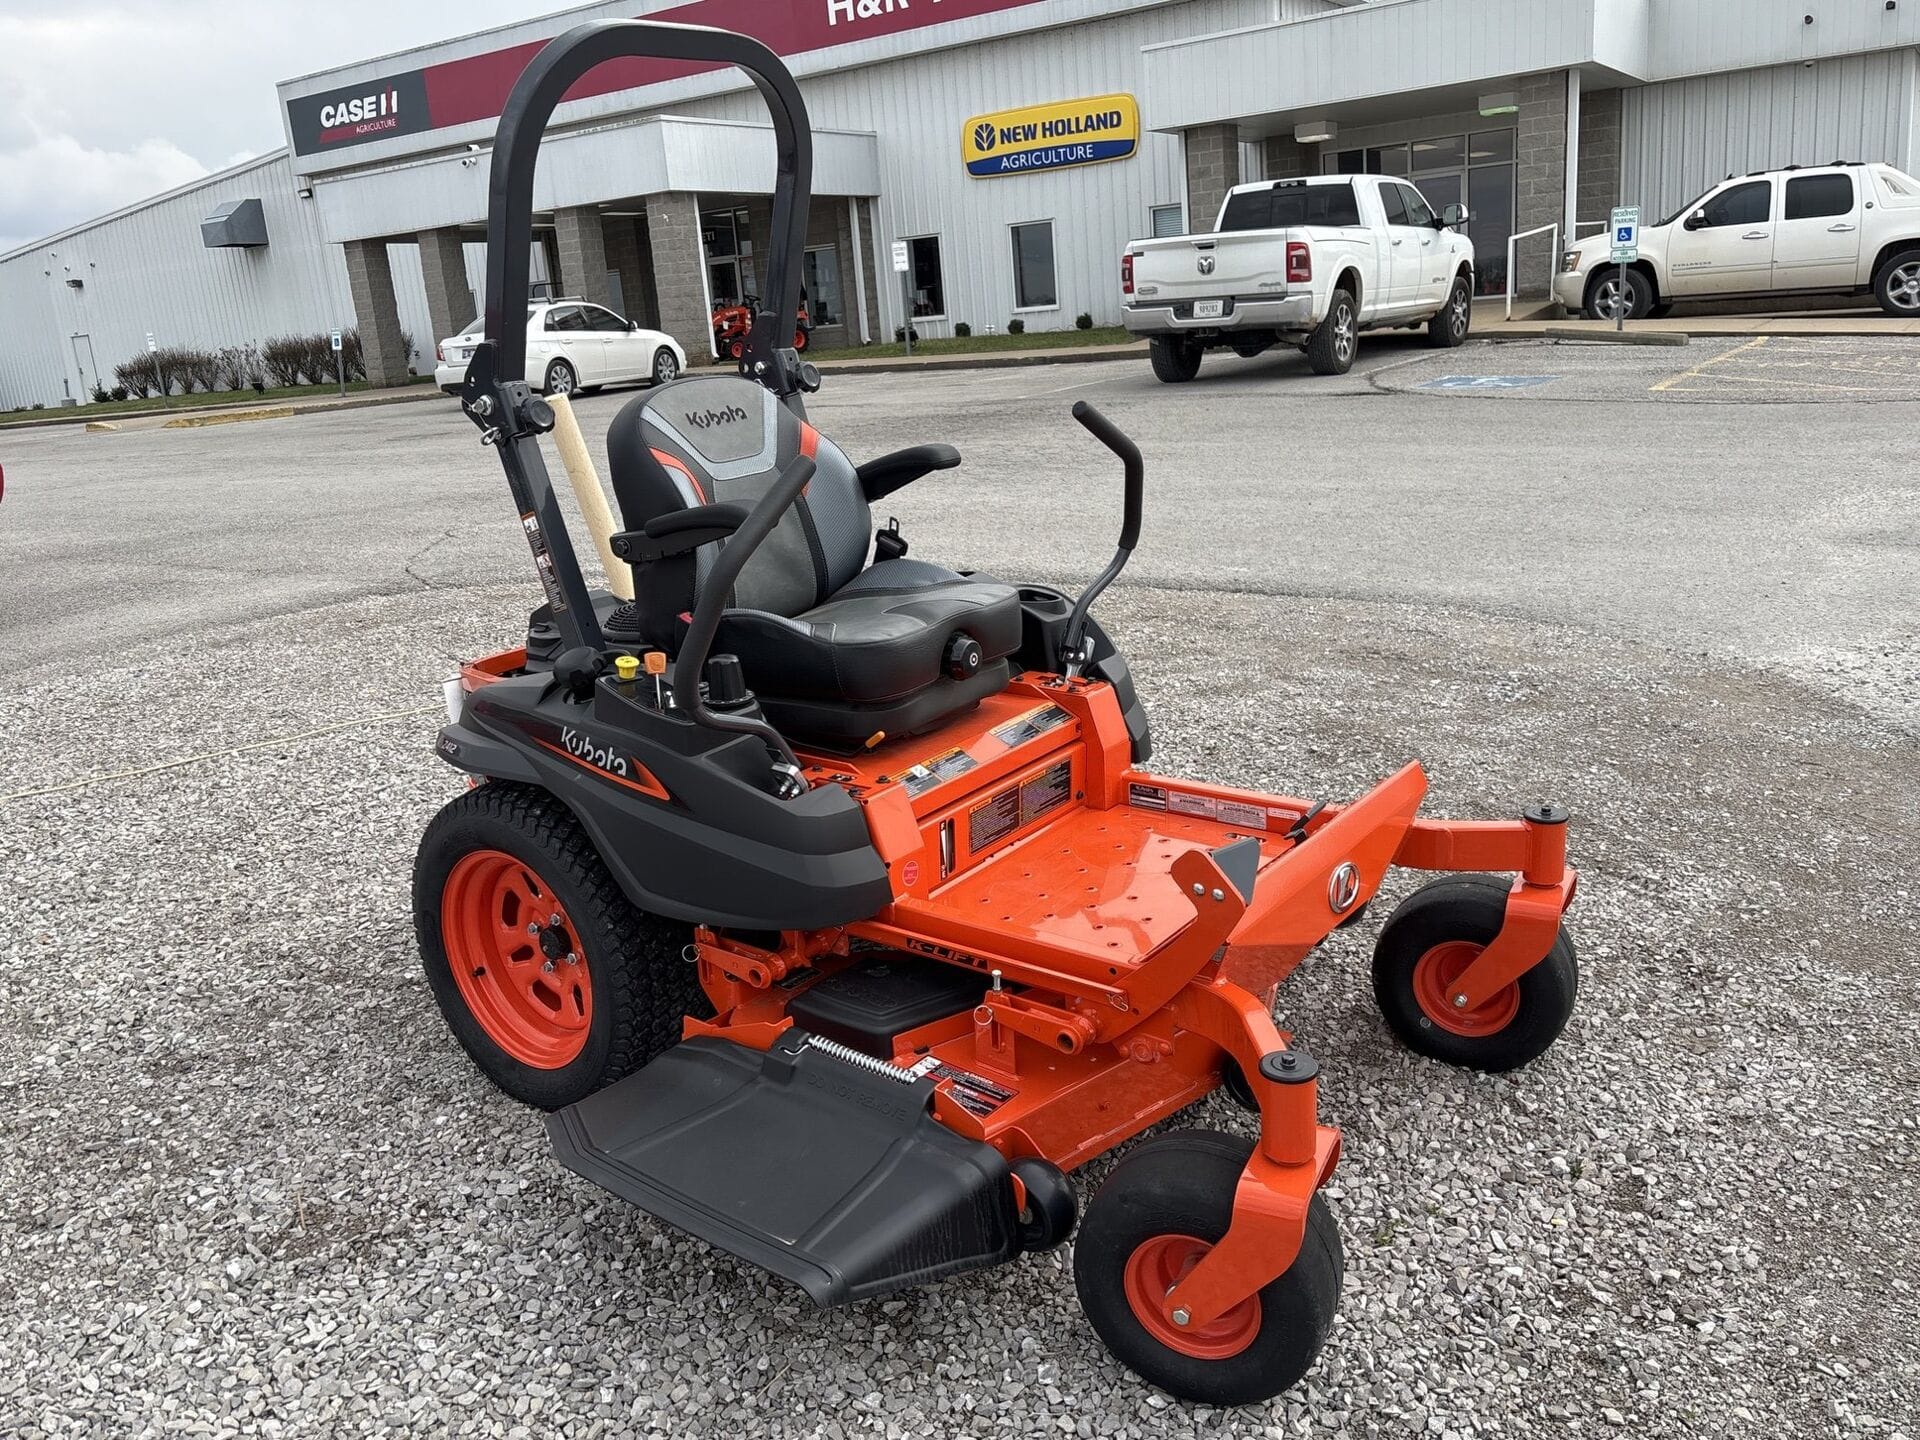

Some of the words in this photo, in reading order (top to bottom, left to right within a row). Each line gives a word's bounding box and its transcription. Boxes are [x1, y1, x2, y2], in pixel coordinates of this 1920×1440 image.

[320, 95, 377, 128] CASE
[356, 118, 396, 134] AGRICULTURE
[1000, 122, 1038, 145] NEW
[1041, 110, 1122, 138] HOLLAND
[1000, 144, 1094, 170] AGRICULTURE
[1613, 209, 1638, 217] RESERVED
[685, 404, 748, 429] Kubota
[561, 725, 627, 777] Kubota
[909, 940, 985, 967] K-LIFT
